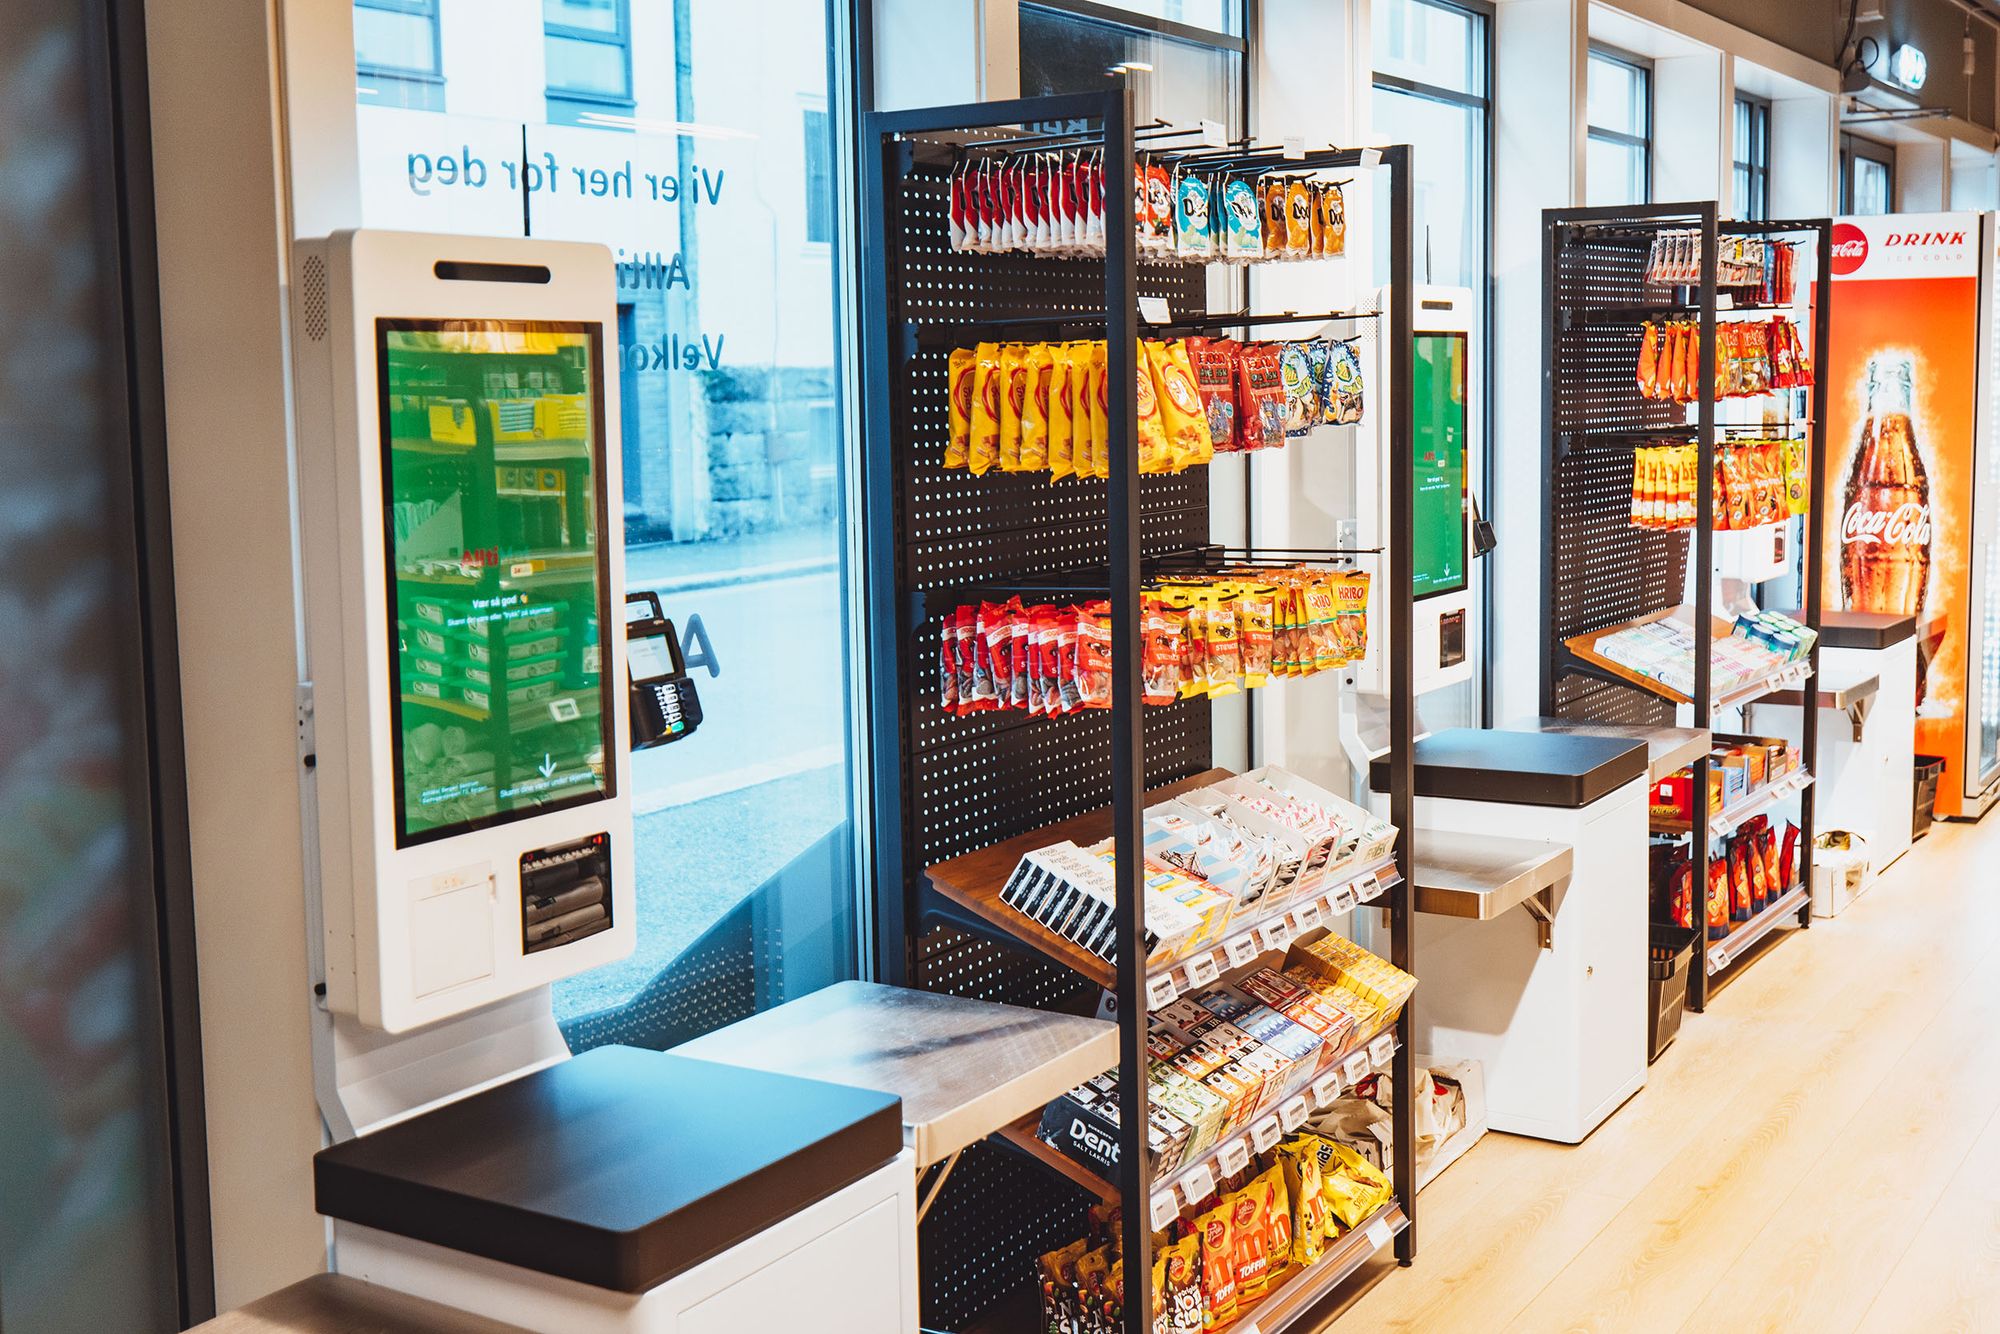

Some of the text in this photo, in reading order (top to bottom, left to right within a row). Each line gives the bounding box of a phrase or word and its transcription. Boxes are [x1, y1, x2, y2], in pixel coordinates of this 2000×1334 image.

[1884, 230, 1968, 247] DRINK
[1922, 253, 1964, 263] COLD
[1841, 501, 1931, 546] Coca-Cola
[1068, 1117, 1121, 1163] Dent
[1072, 1140, 1111, 1168] SALT LAKRIS
